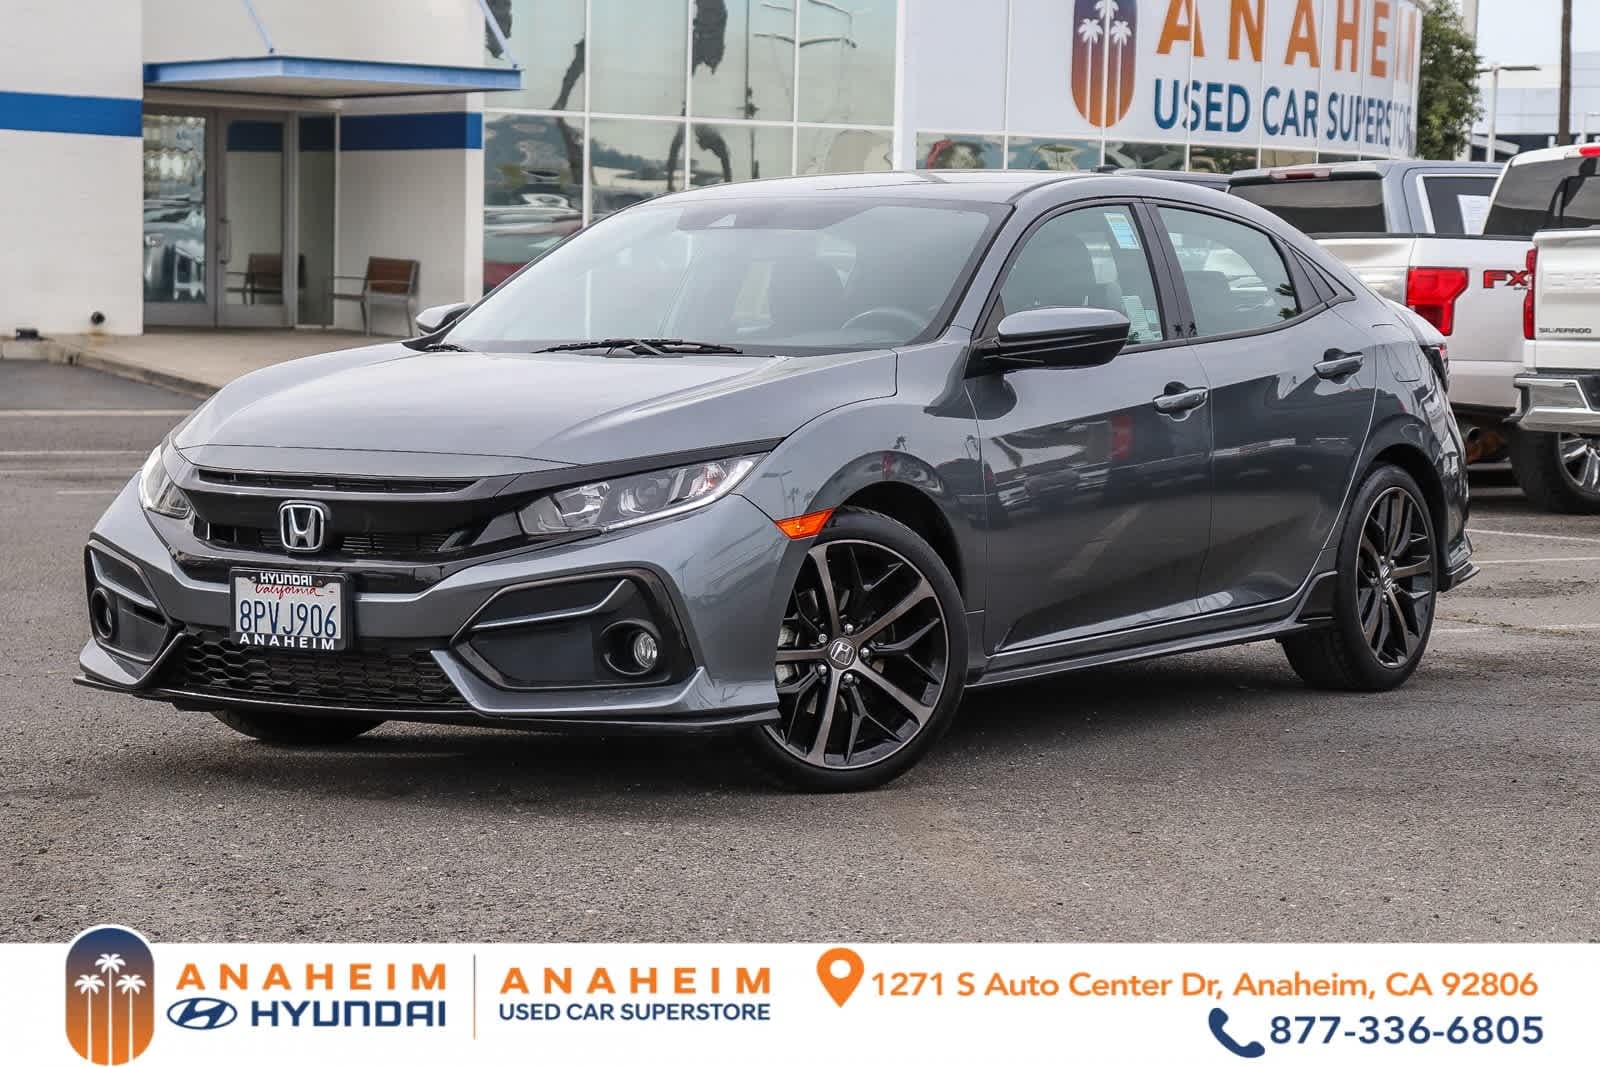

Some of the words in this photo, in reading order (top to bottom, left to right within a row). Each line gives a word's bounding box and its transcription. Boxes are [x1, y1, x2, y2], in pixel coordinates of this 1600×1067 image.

[1154, 78, 1250, 132] USED
[1262, 86, 1319, 137] CAR
[1483, 269, 1529, 288] FX
[260, 572, 313, 586] HYUNDAI
[255, 583, 323, 600] California
[240, 600, 337, 638] 8PVJ906
[239, 633, 335, 650] ANAHEIM
